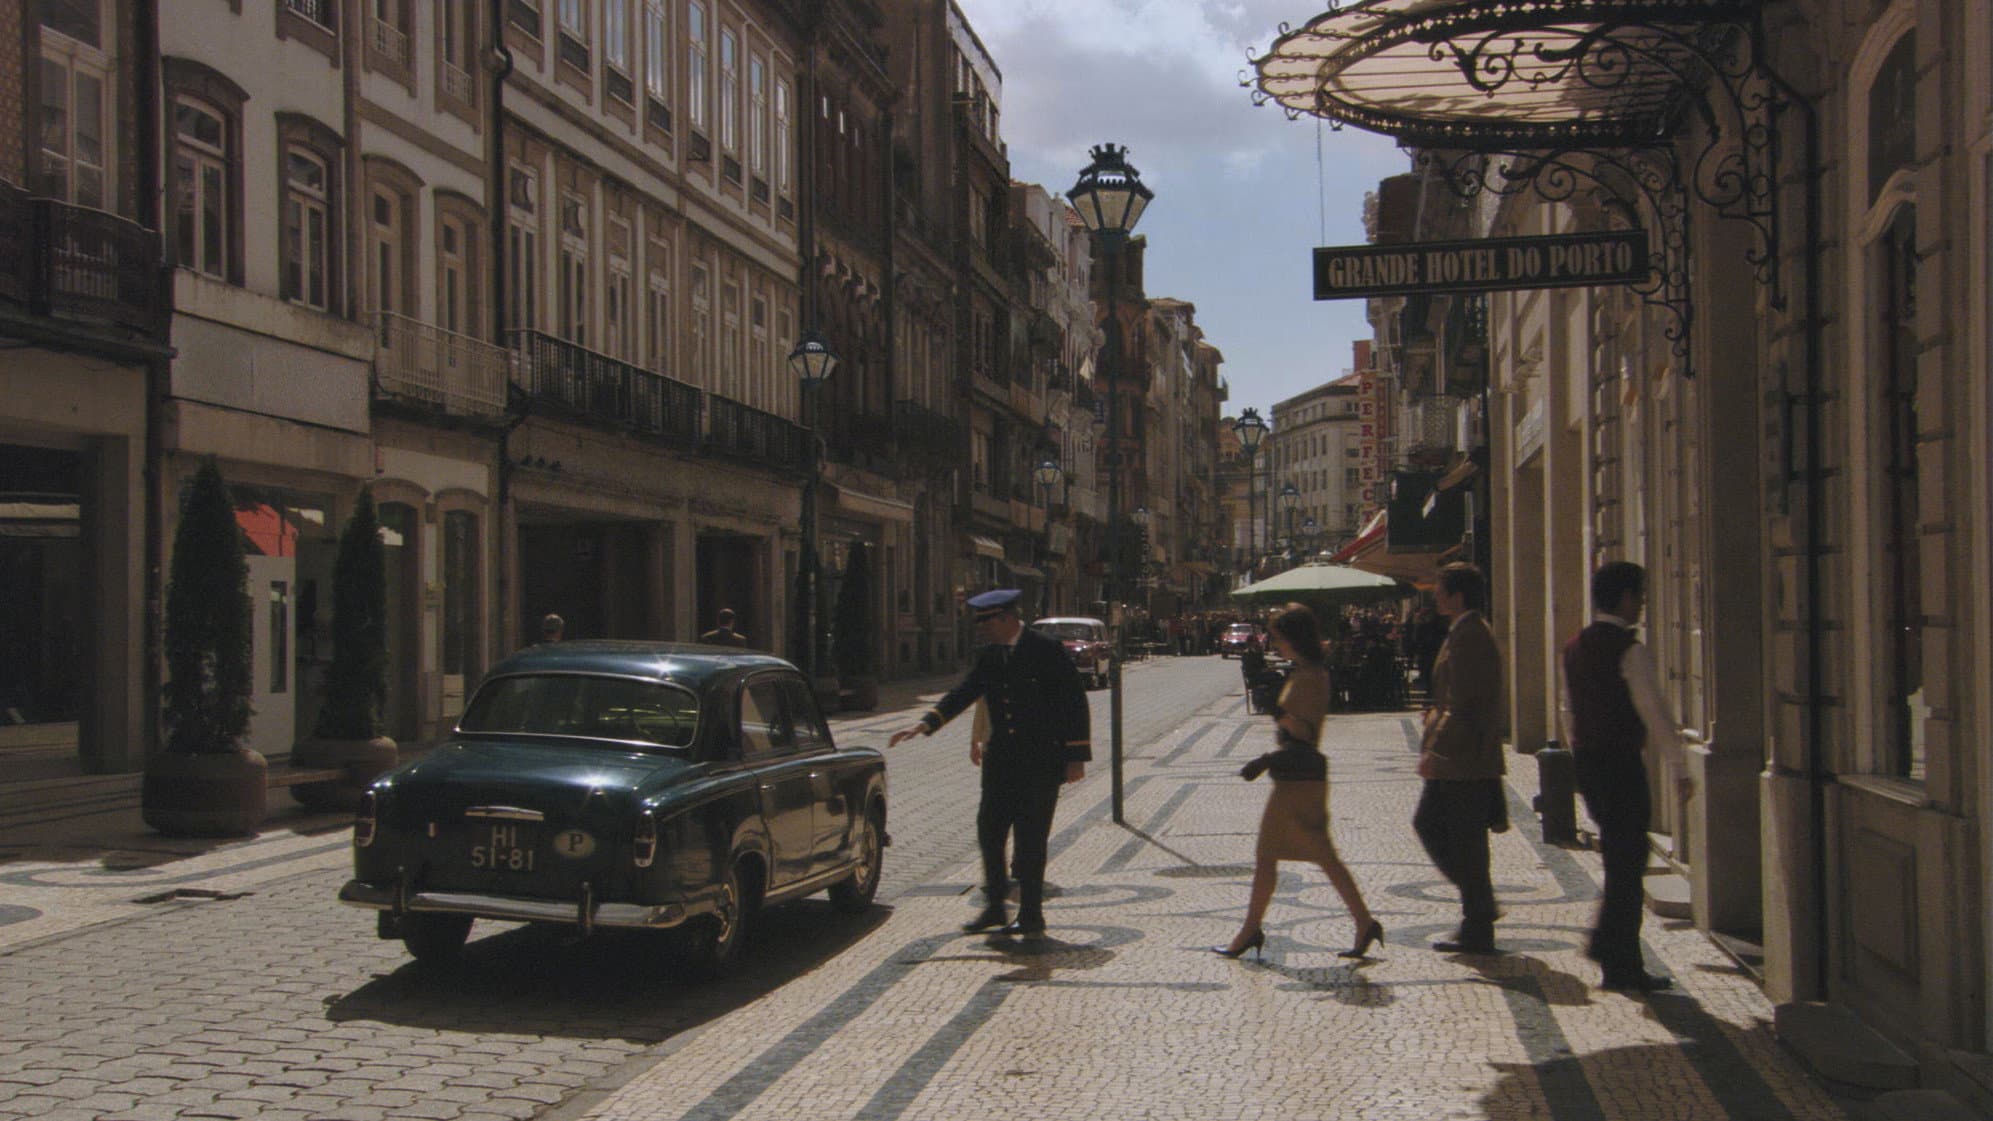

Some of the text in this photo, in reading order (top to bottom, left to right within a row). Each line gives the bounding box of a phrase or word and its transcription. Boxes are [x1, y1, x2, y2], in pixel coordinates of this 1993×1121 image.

[1328, 240, 1634, 288] GRANDE HOTEL DO PORTO
[491, 826, 517, 848] HI
[568, 832, 584, 852] P
[470, 846, 534, 872] 51-81
